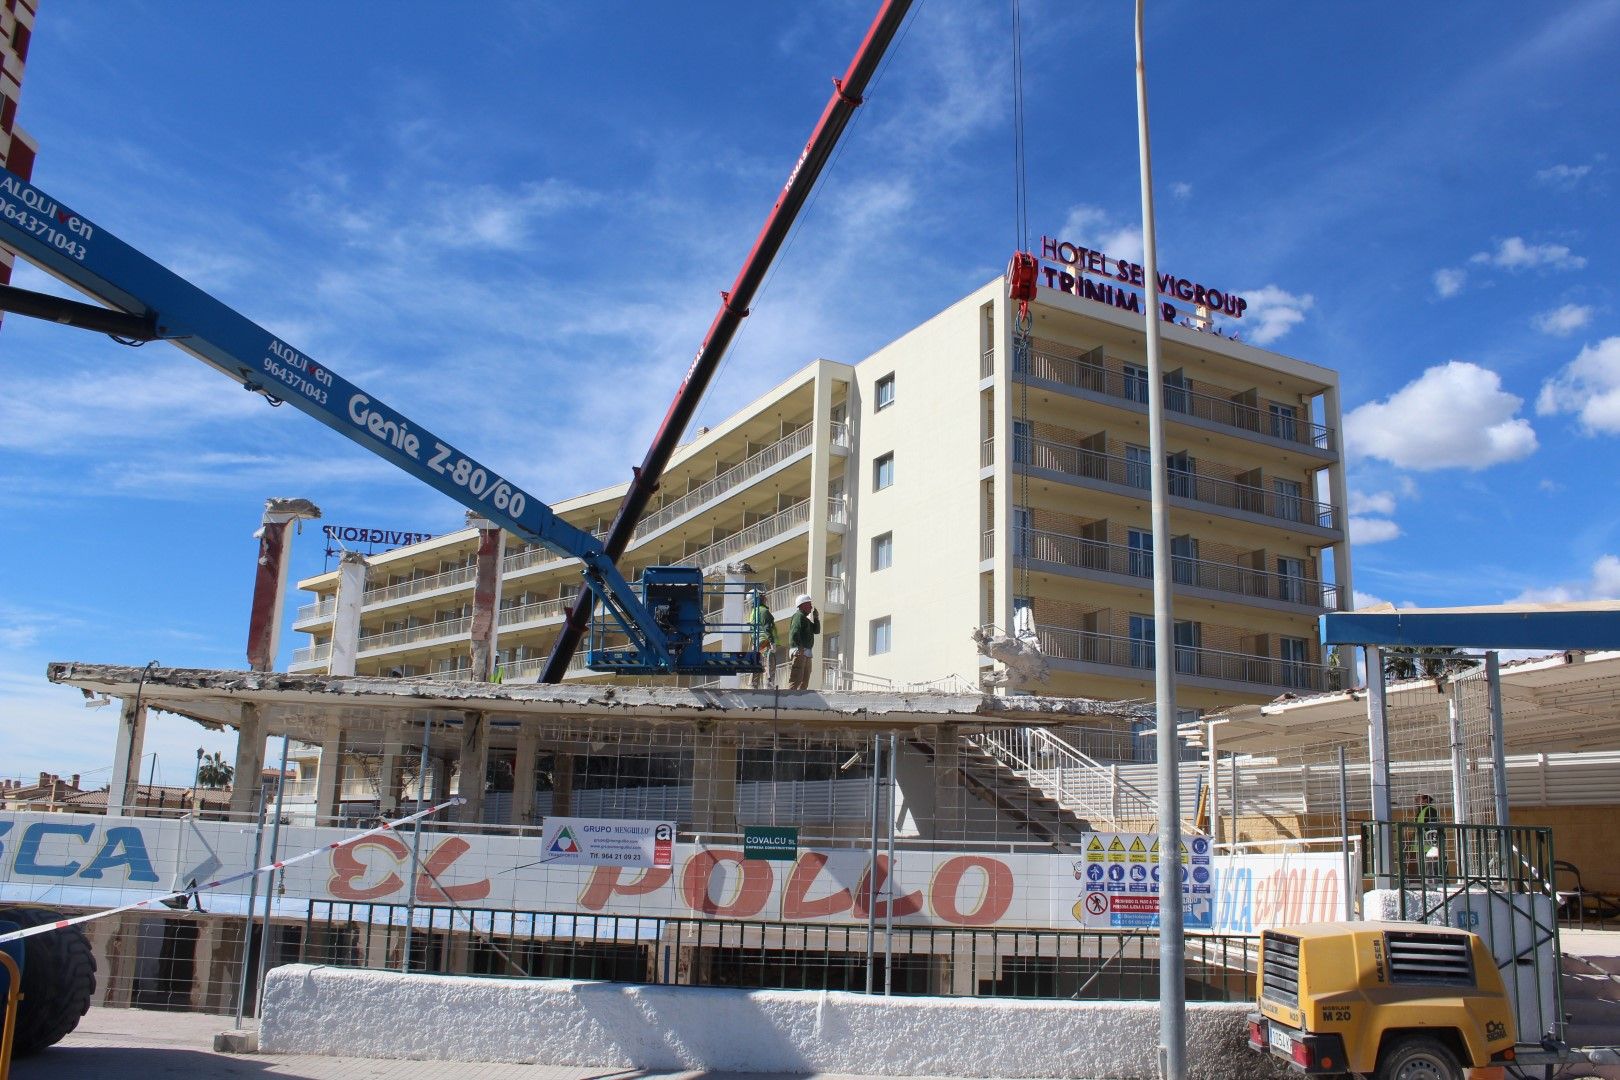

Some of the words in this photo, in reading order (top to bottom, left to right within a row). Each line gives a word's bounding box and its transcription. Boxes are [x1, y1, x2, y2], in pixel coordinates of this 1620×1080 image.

[1041, 235, 1112, 277] HOTEL
[1117, 260, 1248, 318] SEVIGROUP
[1041, 266, 1177, 323] TRINIMR
[264, 358, 327, 405] 964371043
[349, 394, 420, 460] Genie
[427, 442, 525, 518] Z-80/60
[583, 825, 612, 833] GRUPO
[746, 836, 787, 845] COVALCU
[578, 850, 1014, 925] POLLO
[1373, 939, 1385, 982] KAESER
[1322, 1011, 1334, 1021] M
[1336, 1011, 1351, 1021] 20
